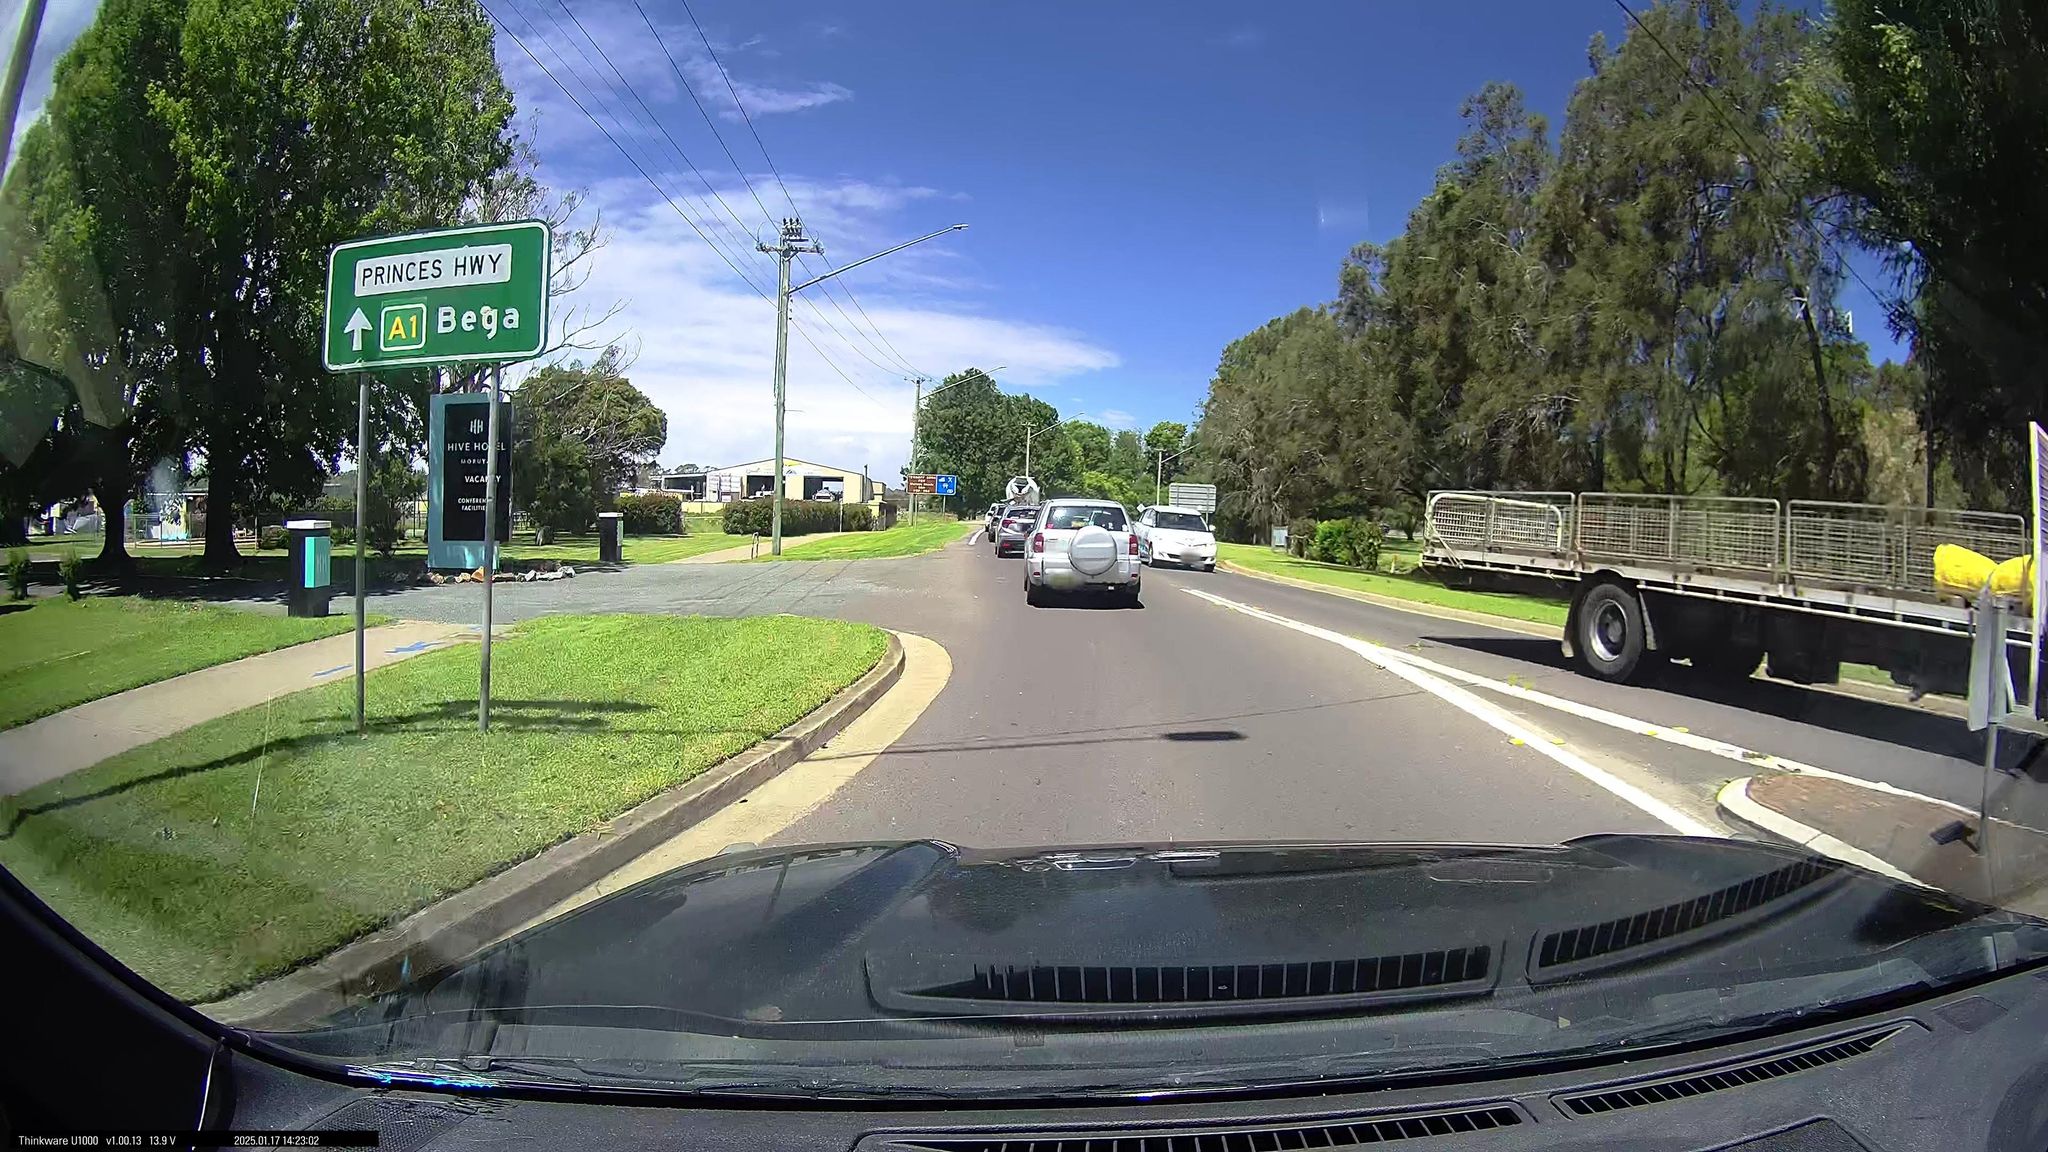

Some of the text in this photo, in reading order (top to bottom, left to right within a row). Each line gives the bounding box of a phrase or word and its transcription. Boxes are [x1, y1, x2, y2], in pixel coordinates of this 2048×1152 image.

[362, 253, 503, 287] PRINCES HWY
[388, 305, 520, 341] A1 Bega
[447, 442, 506, 451] HIVE HOEL
[464, 475, 501, 483] VACANY
